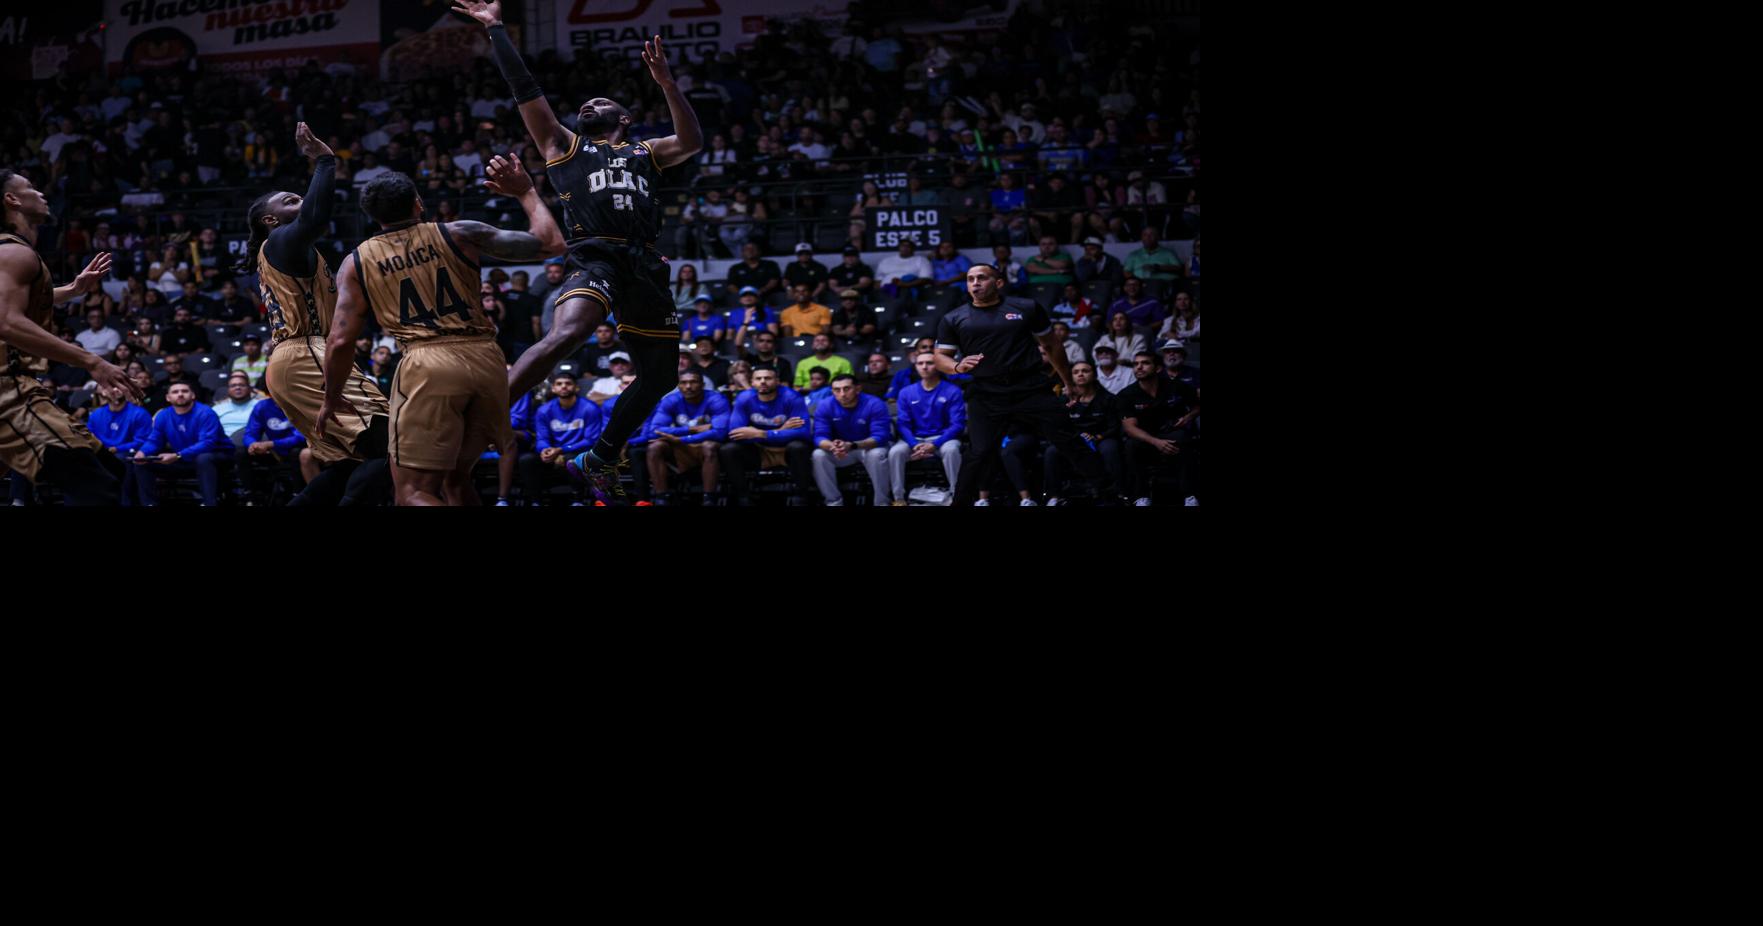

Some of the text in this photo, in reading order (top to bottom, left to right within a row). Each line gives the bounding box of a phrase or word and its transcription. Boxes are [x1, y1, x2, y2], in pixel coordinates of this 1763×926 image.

[120, 0, 272, 25] Hace
[233, 12, 338, 45] masa
[570, 22, 721, 46] BRAULIO
[864, 172, 908, 189] LUB
[612, 194, 634, 211] 24
[876, 209, 938, 227] PALCO
[927, 229, 941, 246] 5
[378, 244, 440, 276] MOJICA
[400, 266, 472, 329] 44
